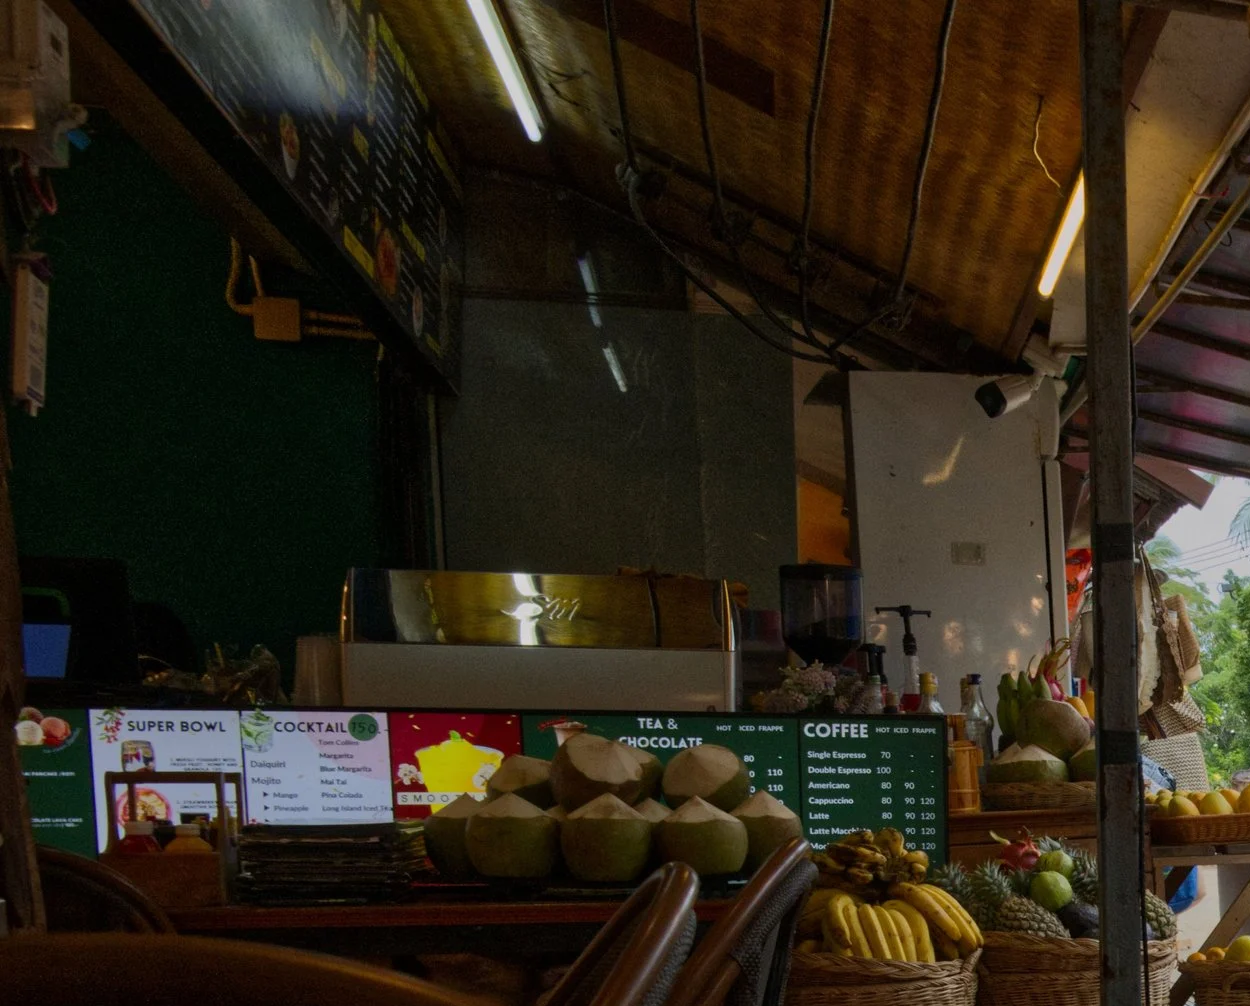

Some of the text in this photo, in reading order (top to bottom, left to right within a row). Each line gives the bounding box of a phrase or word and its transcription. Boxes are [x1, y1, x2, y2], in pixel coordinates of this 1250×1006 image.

[127, 720, 226, 732] SUPER BOWL
[274, 721, 347, 733] COCKTAIL
[637, 717, 679, 730] TEA &
[803, 723, 869, 738] COFFEE
[319, 752, 354, 760] Margarita
[807, 751, 891, 760] Single Espresso 70
[250, 760, 286, 769] Daiquiri
[808, 766, 837, 774] Double
[837, 767, 872, 775] Espresso
[251, 777, 281, 786] Mojito
[808, 781, 850, 789] Americano
[767, 784, 783, 792] 110
[808, 796, 854, 806] Cappuccino
[904, 797, 915, 805] 90
[920, 797, 935, 805] 120
[905, 812, 916, 820] 90
[921, 812, 935, 820] 120
[809, 827, 830, 835] Latte
[905, 827, 916, 835] 90
[921, 827, 936, 835] 120
[905, 842, 916, 850] 90
[921, 842, 936, 850] 120
